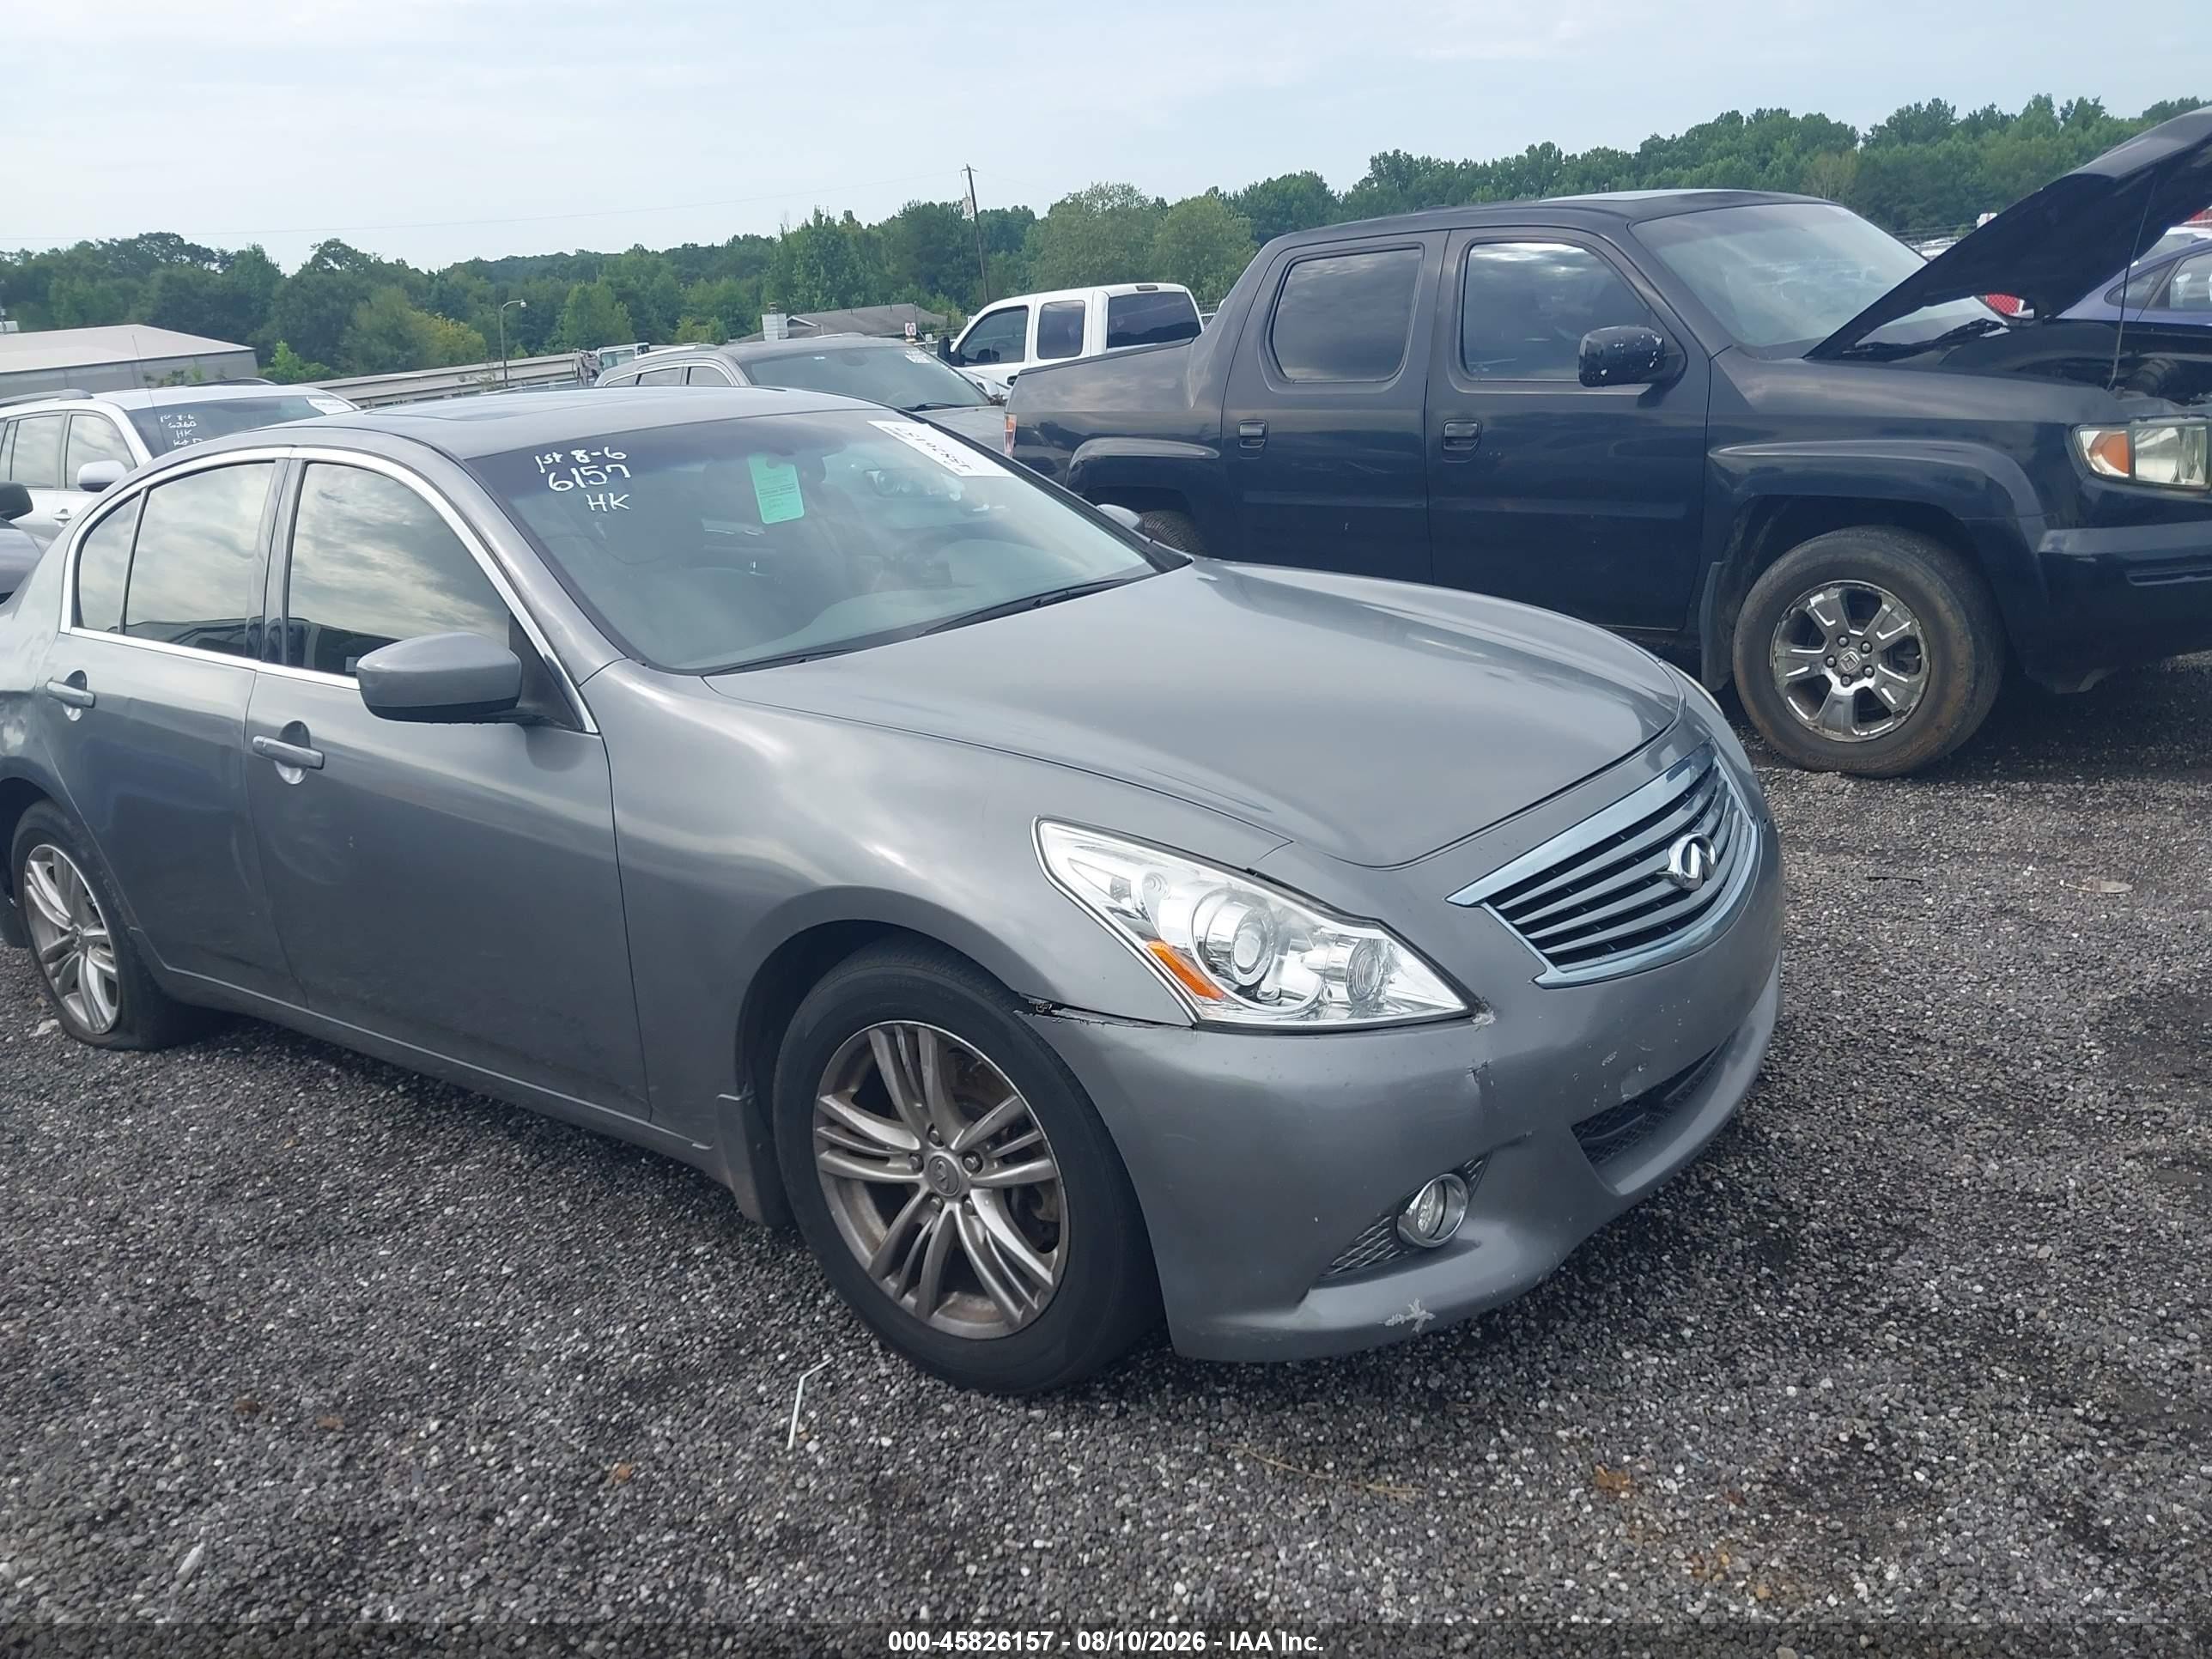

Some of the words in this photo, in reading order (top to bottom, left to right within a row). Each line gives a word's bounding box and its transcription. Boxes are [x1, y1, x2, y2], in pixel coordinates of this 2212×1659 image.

[176, 429, 192, 439] HK
[571, 447, 627, 463] 8-6
[549, 464, 631, 492] 6157
[586, 493, 630, 511] HK
